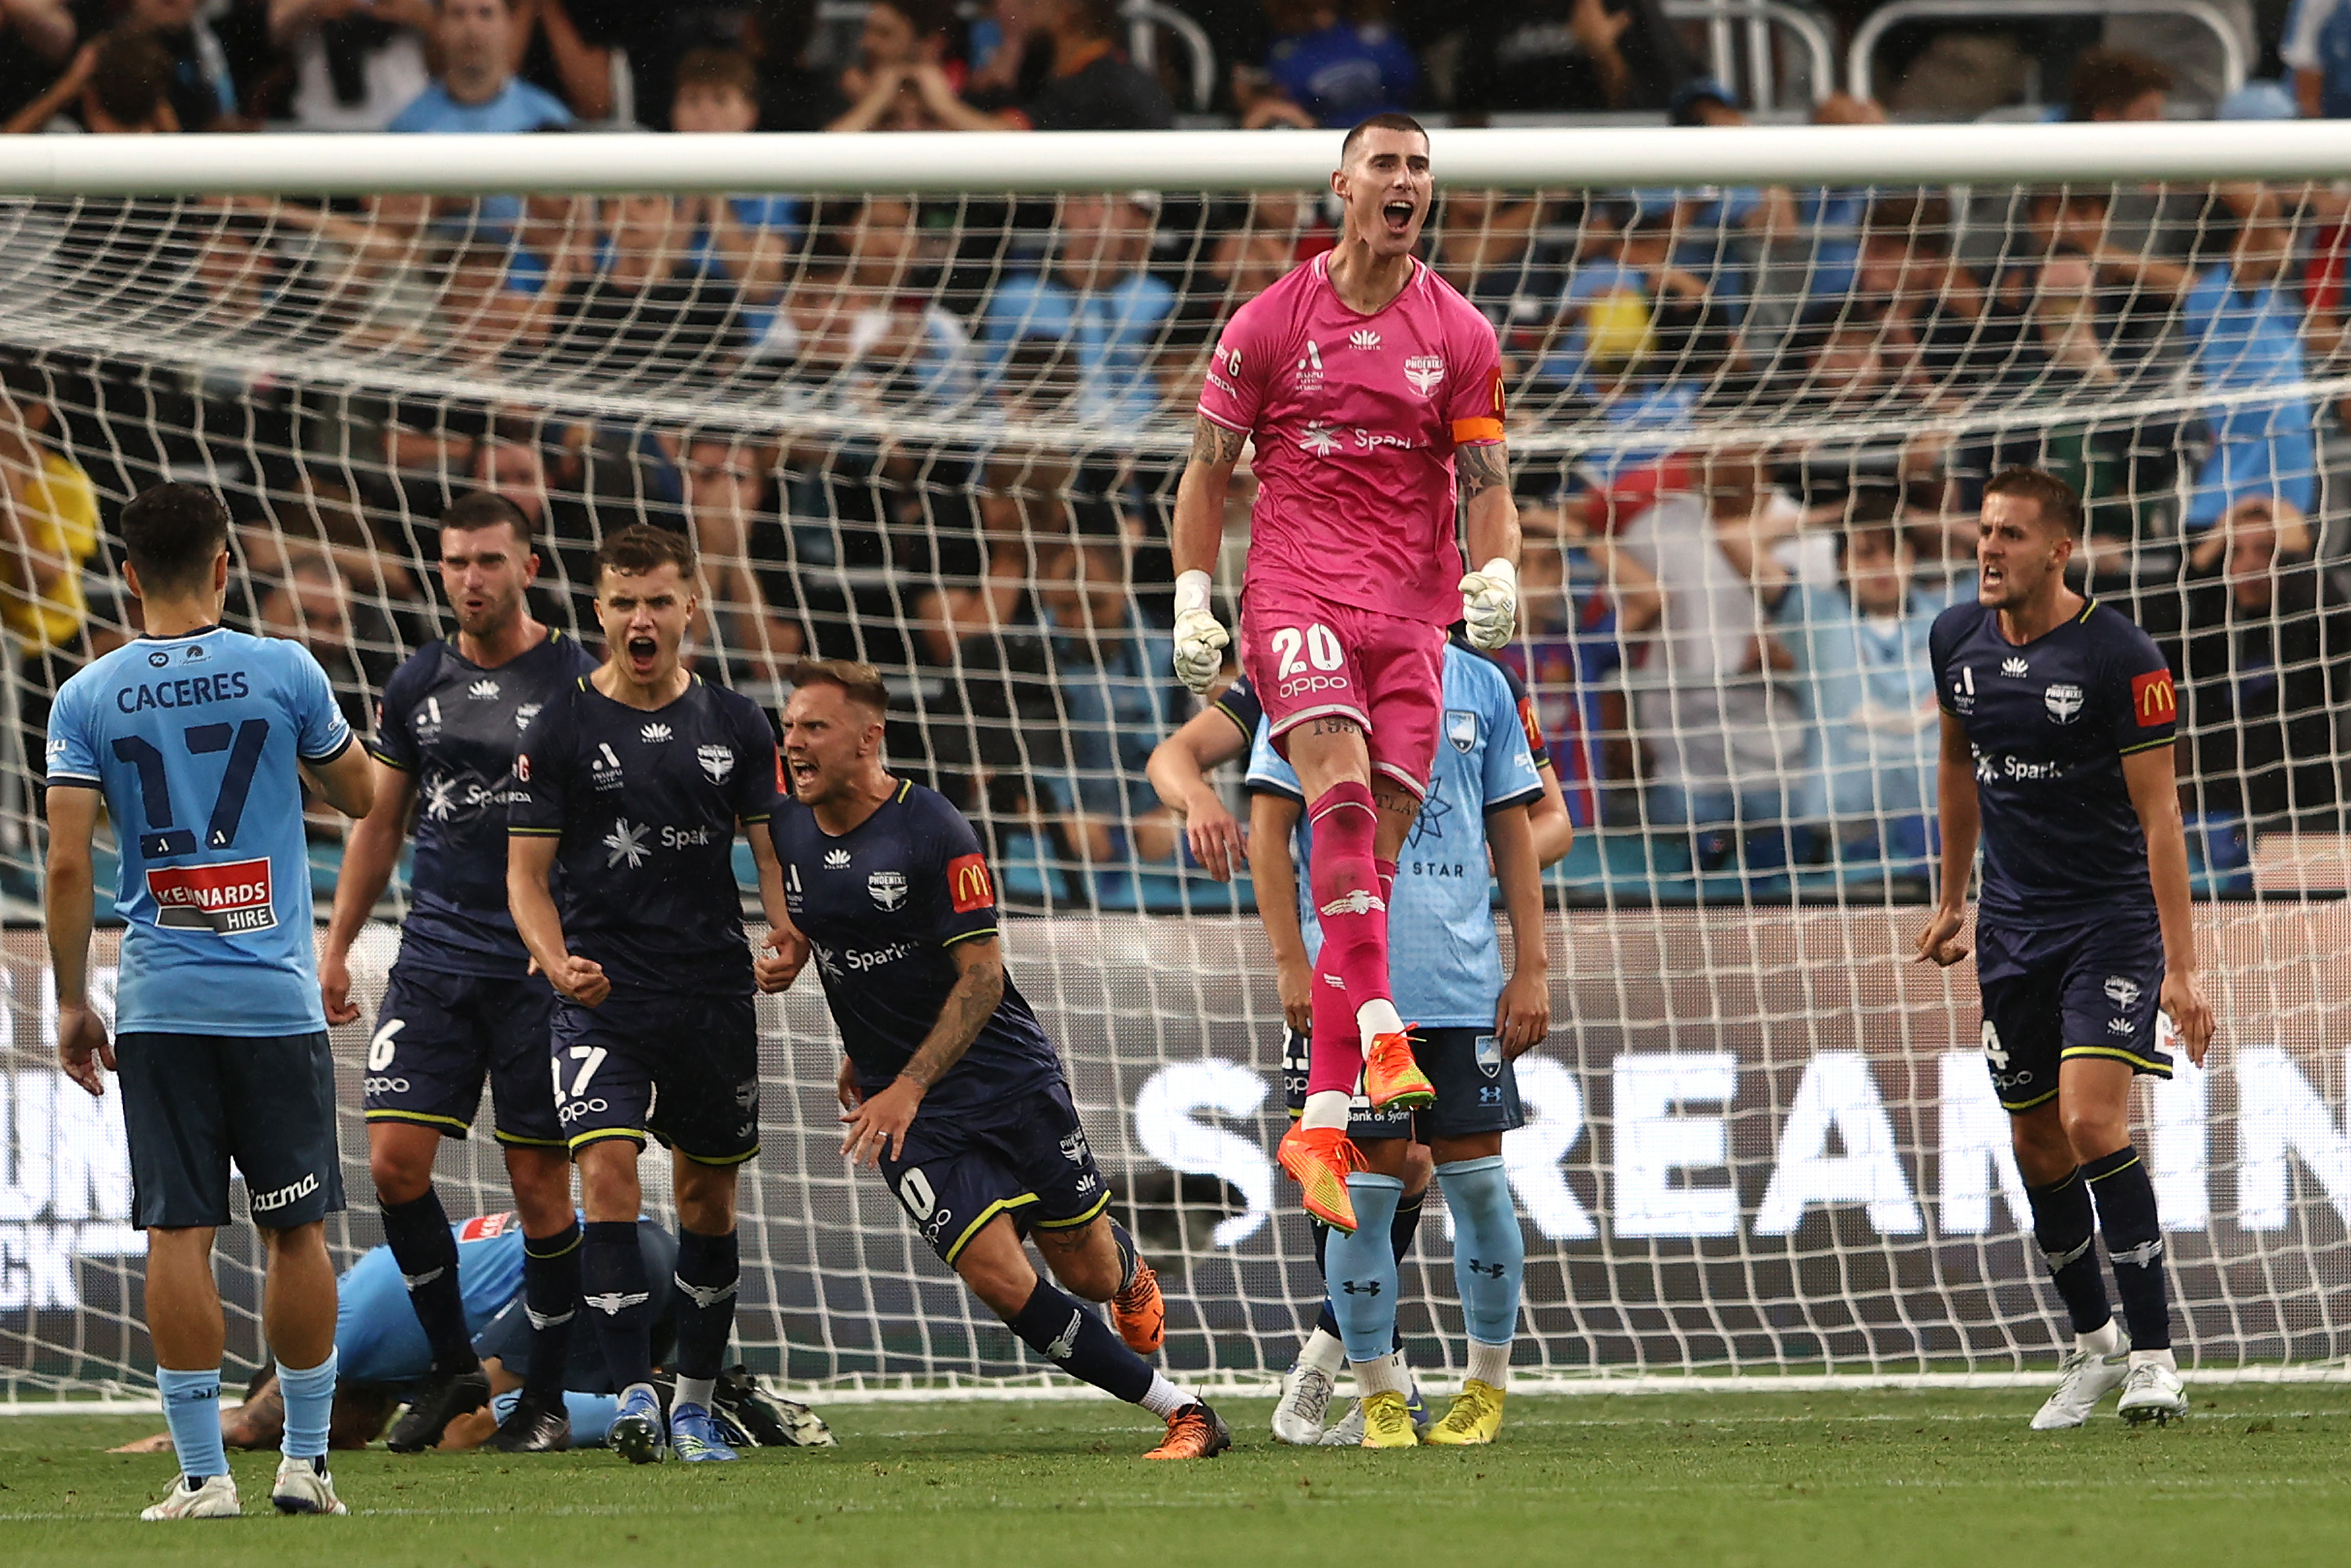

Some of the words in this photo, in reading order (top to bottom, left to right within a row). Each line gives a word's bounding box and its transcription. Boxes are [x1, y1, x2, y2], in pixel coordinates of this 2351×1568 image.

[1272, 623, 1343, 682] 20
[117, 671, 249, 714] CACERES
[1280, 675, 1348, 698] oppo
[111, 718, 270, 858] 17
[1413, 862, 1463, 878] STAR
[226, 908, 269, 929] HIRE
[368, 1019, 406, 1071] 6
[364, 1077, 411, 1097] ppo
[558, 1099, 608, 1128] ppo
[1347, 1110, 1372, 1121] Bank
[251, 1172, 320, 1212] arma
[900, 1167, 936, 1221] 0
